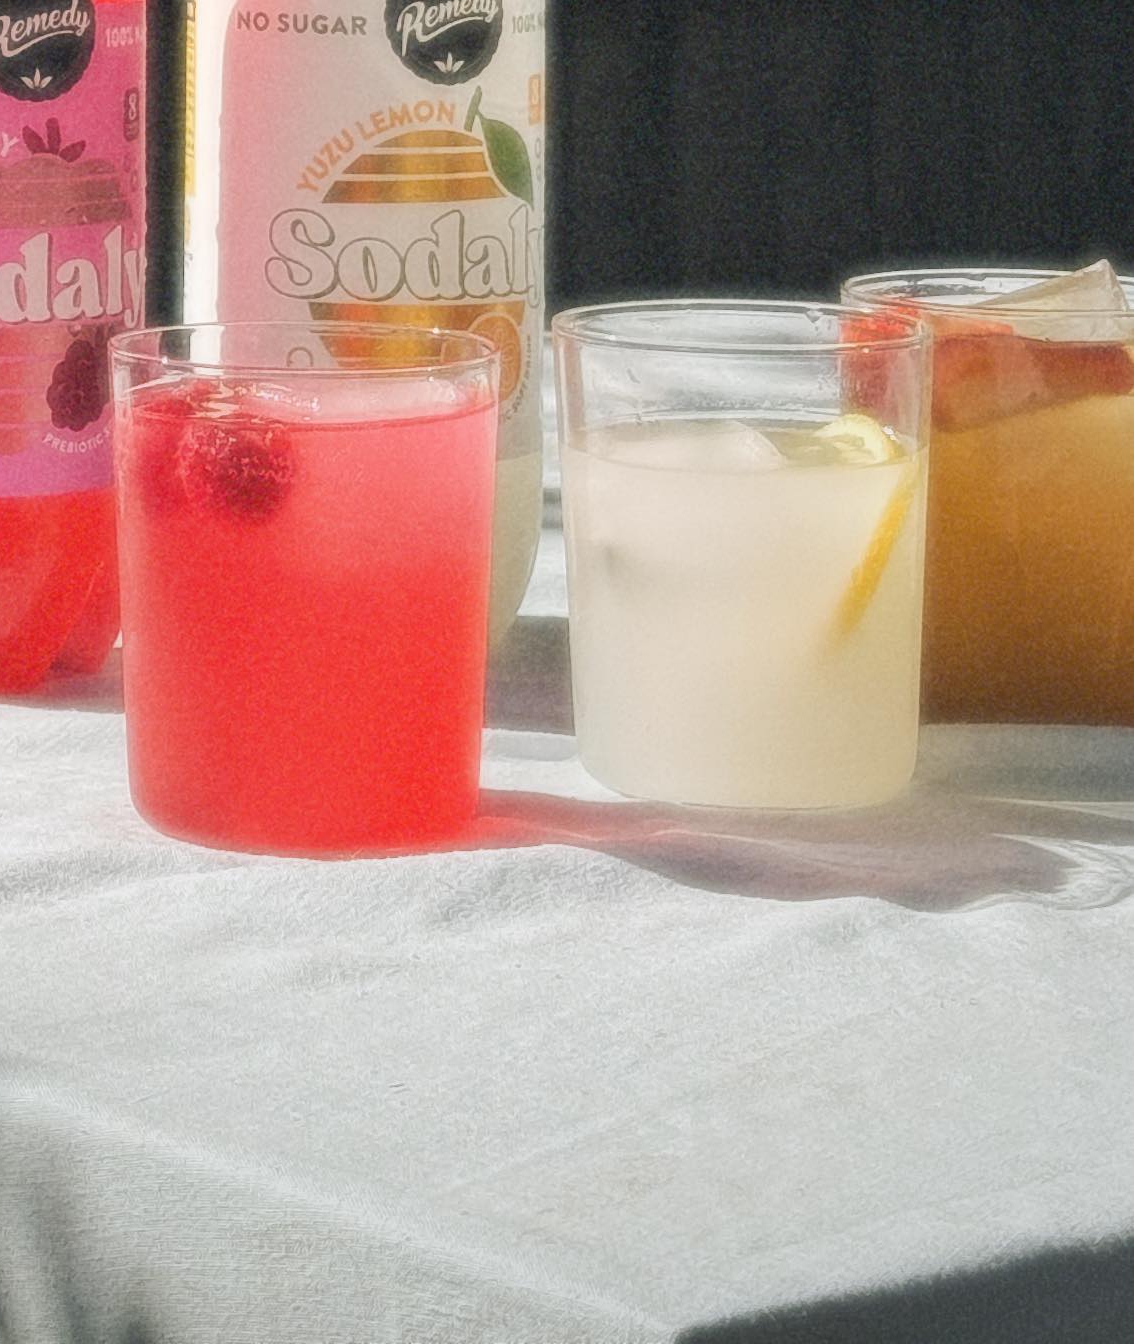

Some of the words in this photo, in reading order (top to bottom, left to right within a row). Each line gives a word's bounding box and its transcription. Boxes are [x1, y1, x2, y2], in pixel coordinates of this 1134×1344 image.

[236, 11, 270, 32] NO
[277, 13, 367, 36] SUGAR
[296, 127, 355, 192] YUZU
[354, 99, 456, 141] LEMON
[42, 430, 104, 453] PREBIOTIC
